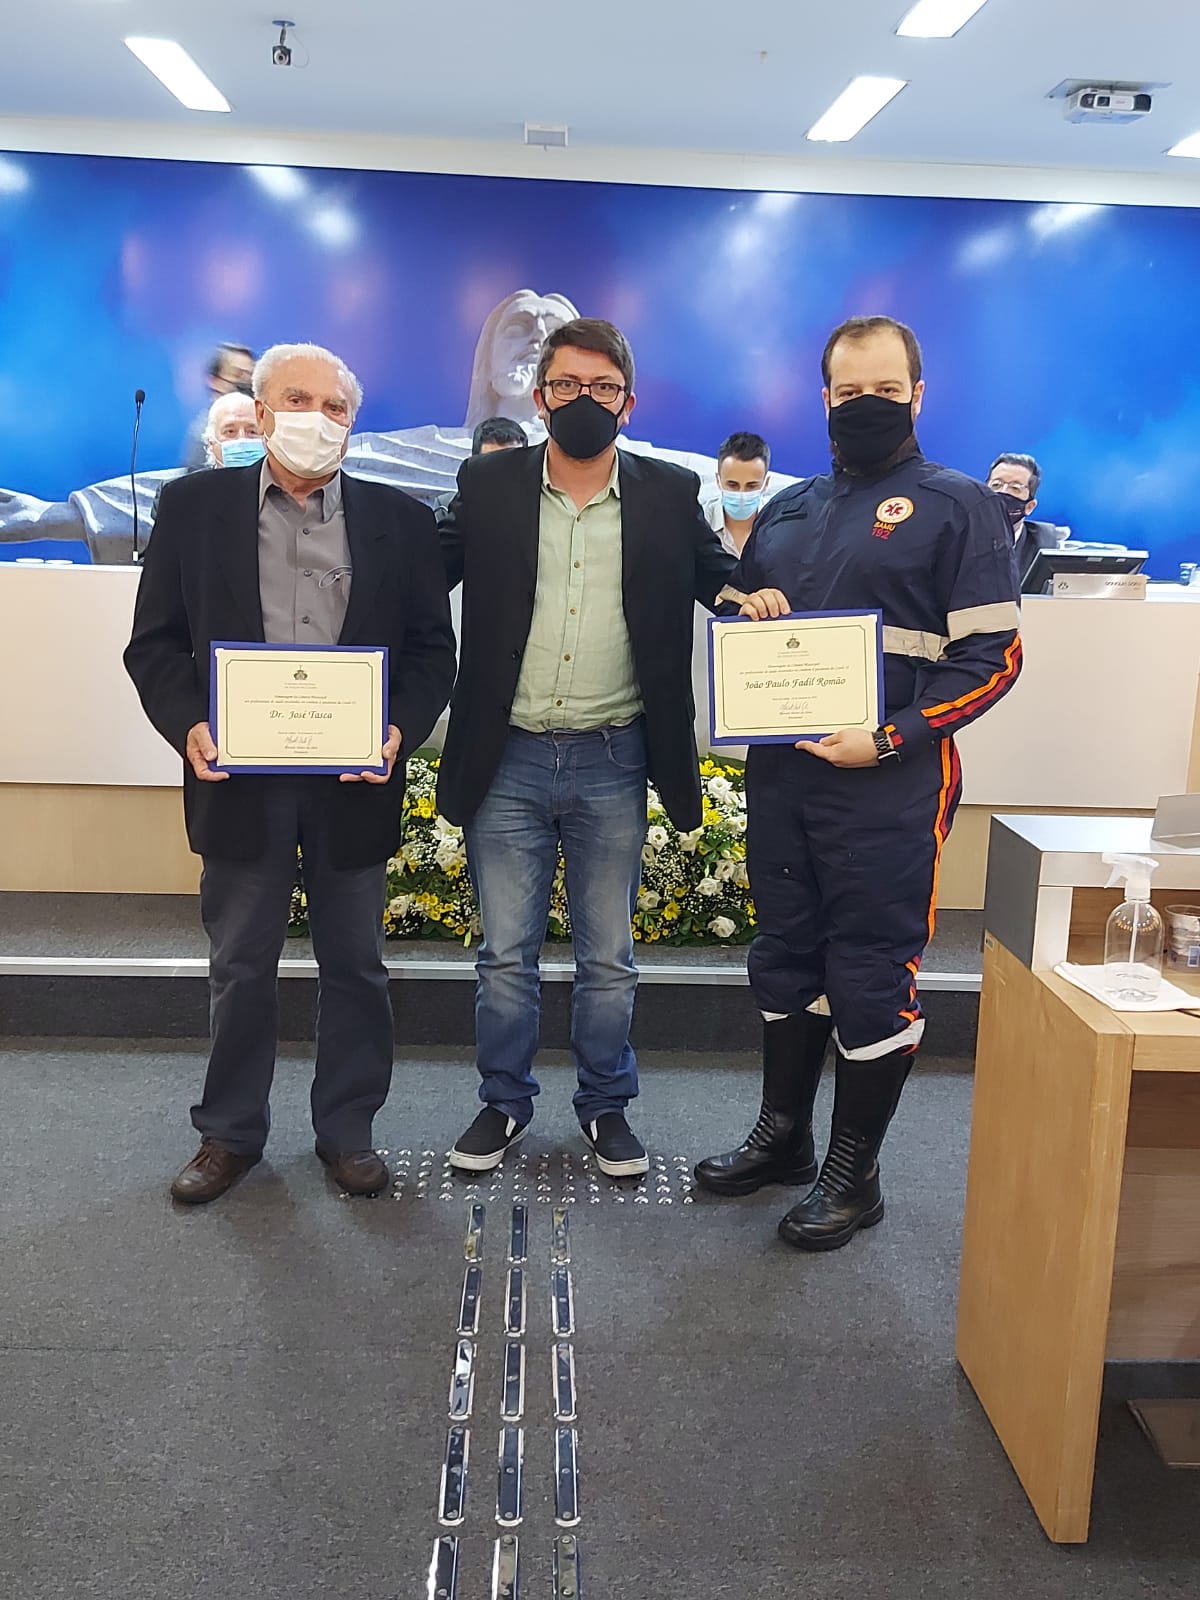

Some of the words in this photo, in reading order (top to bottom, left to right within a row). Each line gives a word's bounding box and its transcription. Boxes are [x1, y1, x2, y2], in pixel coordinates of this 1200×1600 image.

[871, 527, 891, 540] 192
[743, 680, 764, 691] João
[765, 678, 790, 688] Paulo
[816, 676, 846, 687] Romão
[269, 710, 285, 718] Dr.
[288, 709, 307, 719] José
[308, 710, 333, 719] Tasca
